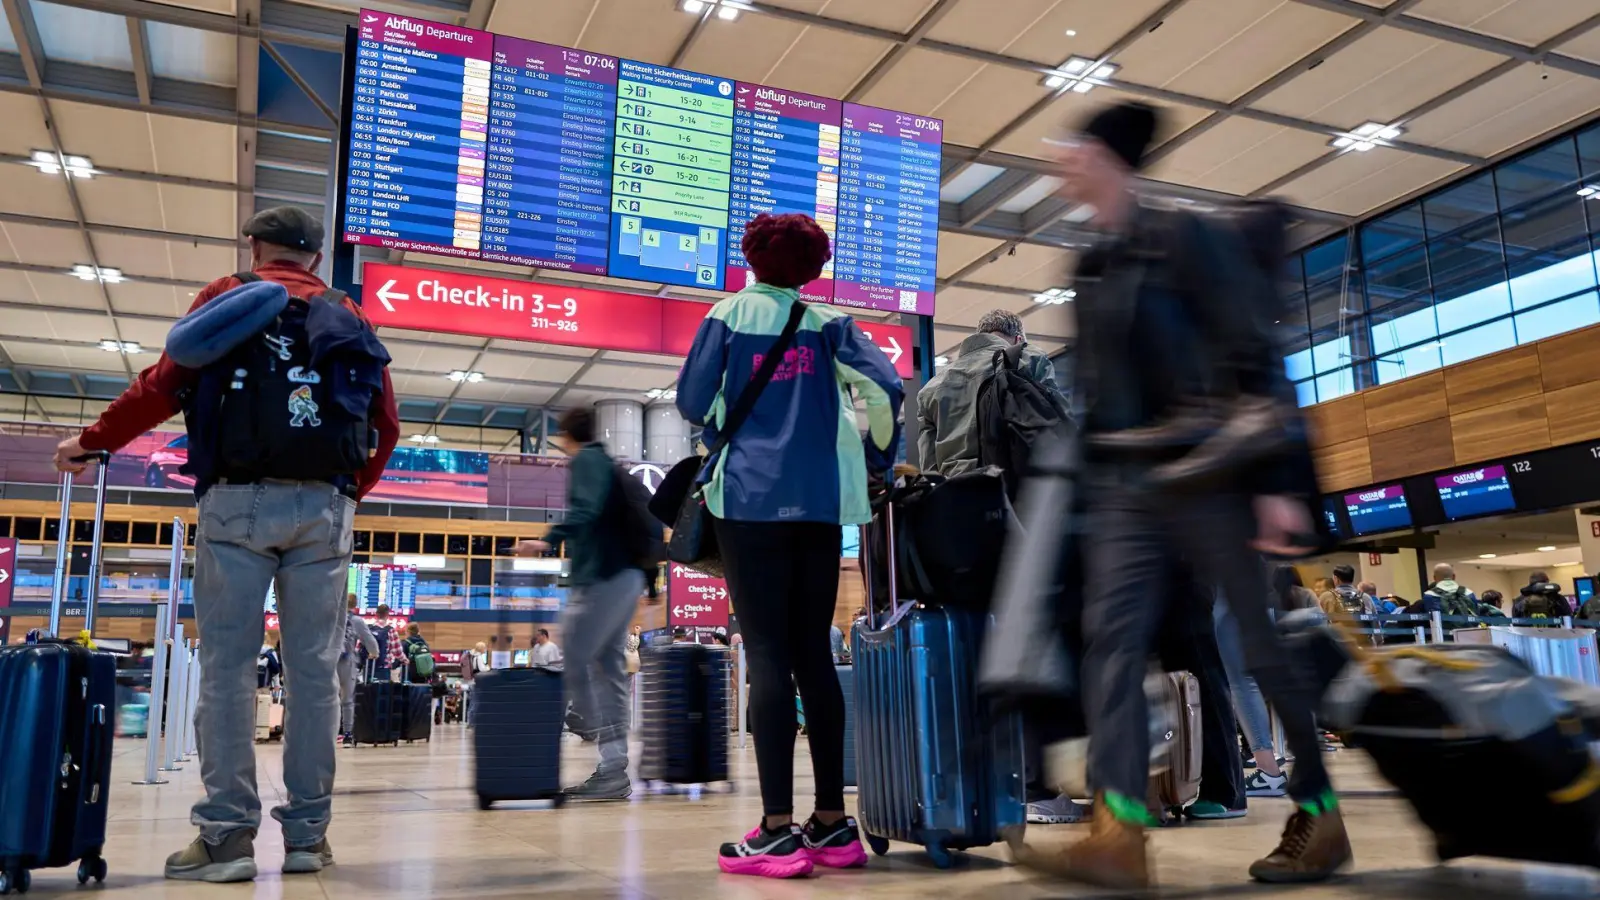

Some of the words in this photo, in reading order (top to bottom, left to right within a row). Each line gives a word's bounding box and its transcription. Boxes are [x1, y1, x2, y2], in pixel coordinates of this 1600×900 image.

[385, 17, 423, 36] Abflug
[426, 26, 473, 43] Departure
[361, 40, 379, 49] 05:20
[383, 44, 402, 53] Palma
[412, 50, 437, 60] Mallorca
[361, 49, 378, 58] 06:00
[382, 53, 407, 65] Venedig
[562, 51, 567, 61] 1
[584, 54, 615, 70] 07:04
[360, 58, 378, 67] 06:00
[382, 62, 416, 74] Amsterdam
[359, 68, 377, 76] 06:00
[381, 71, 408, 81] Lissabon
[525, 71, 549, 80] 011-012
[564, 78, 588, 88] Erwartet
[622, 63, 652, 74] Wartezeit
[654, 68, 714, 86] Sicherheitskontrolle
[622, 71, 640, 79] Waiting
[655, 76, 674, 85] Security
[675, 79, 692, 88] Control
[359, 77, 376, 85] 06:10
[381, 80, 401, 89] Dublin
[720, 84, 730, 92] T1
[358, 86, 376, 94] 06:15
[380, 89, 395, 97] Paris
[524, 88, 548, 98] 811-816
[357, 95, 375, 103] 06:25
[379, 98, 416, 110] Thessaloniki
[680, 96, 702, 107] 15-20
[755, 88, 786, 105] Abflug
[788, 96, 826, 110] Departure
[357, 104, 374, 112] 06:45
[378, 107, 398, 116] Zürich
[356, 113, 374, 122] 06:45
[378, 117, 407, 127] Frankfurt
[562, 113, 584, 123] Einstieg
[584, 117, 606, 126] beendet
[679, 115, 696, 124] 9-14
[896, 115, 901, 124] 2
[915, 119, 940, 132] 07:04
[355, 122, 373, 131] 06:55
[377, 126, 400, 135] London
[401, 130, 413, 139] City
[414, 132, 435, 142] Airport
[678, 134, 691, 142] 1-6
[355, 132, 372, 140] 06:55
[376, 135, 410, 146] Köln/Bonn
[354, 141, 372, 149] 06:55
[376, 144, 398, 153] Brüssel
[753, 146, 776, 155] Frankfurt
[353, 150, 371, 158] 07:00
[375, 153, 390, 161] Genf
[678, 153, 698, 162] 16-21
[353, 160, 370, 168] 07:00
[374, 163, 403, 174] Stuttgart
[352, 169, 370, 177] 07:00
[374, 172, 390, 180] Wien
[676, 172, 698, 182] 15-20
[351, 178, 369, 186] 07:00
[390, 184, 403, 193] Orly
[350, 197, 368, 205] 07:10
[373, 190, 396, 200] London
[750, 195, 776, 205] Köln/Bonn
[558, 200, 581, 209] Check-in
[582, 204, 604, 212] beendet
[371, 209, 388, 217] Basel
[371, 218, 390, 227] Zürich
[517, 212, 541, 221] 221-226
[556, 218, 578, 227] Einstieg
[370, 228, 399, 237] München
[394, 240, 410, 249] jeder
[411, 242, 467, 256] Sicherheitskontrolle
[685, 239, 690, 247] 2
[483, 252, 509, 261] sämtliche
[510, 256, 543, 266] Abfluggates
[544, 260, 572, 269] erreichbar.
[416, 280, 524, 312] Check-in
[531, 294, 577, 317] 3–9
[531, 316, 578, 332] 311–926
[1512, 461, 1532, 473] 122
[1453, 472, 1476, 482] QATAR
[1359, 492, 1378, 500] QATAR
